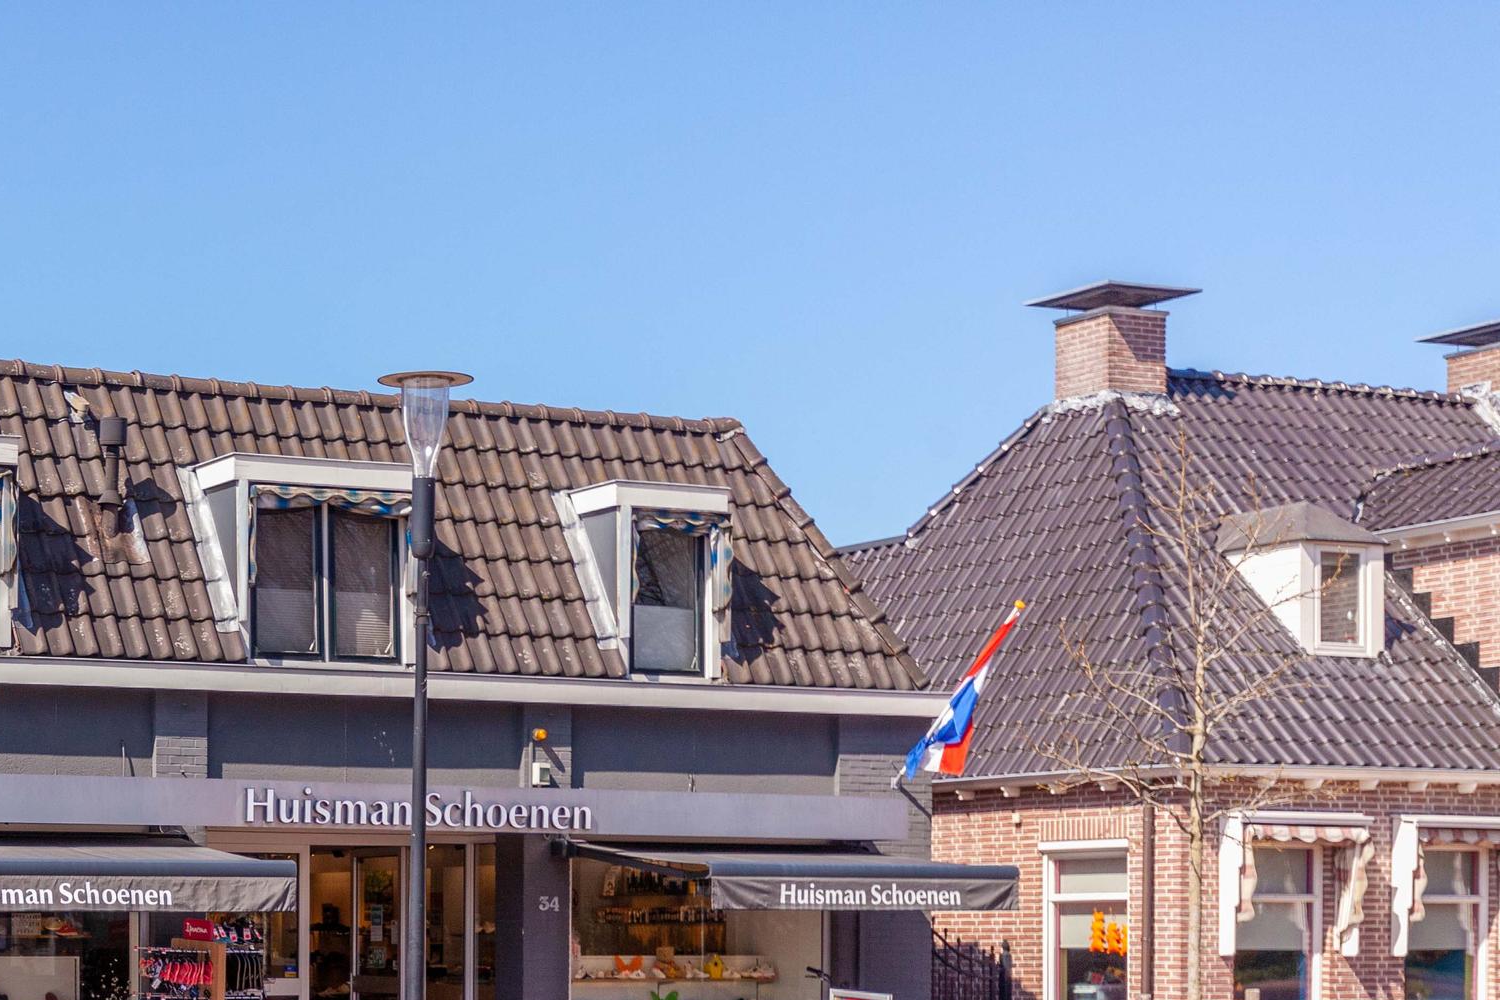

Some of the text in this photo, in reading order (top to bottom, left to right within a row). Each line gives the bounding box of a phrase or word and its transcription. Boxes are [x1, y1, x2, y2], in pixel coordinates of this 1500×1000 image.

[246, 787, 593, 830] Huisman Schoenen
[59, 882, 173, 906] Schoenen
[539, 895, 560, 912] 34
[780, 883, 961, 906] Huisman Schoenen
